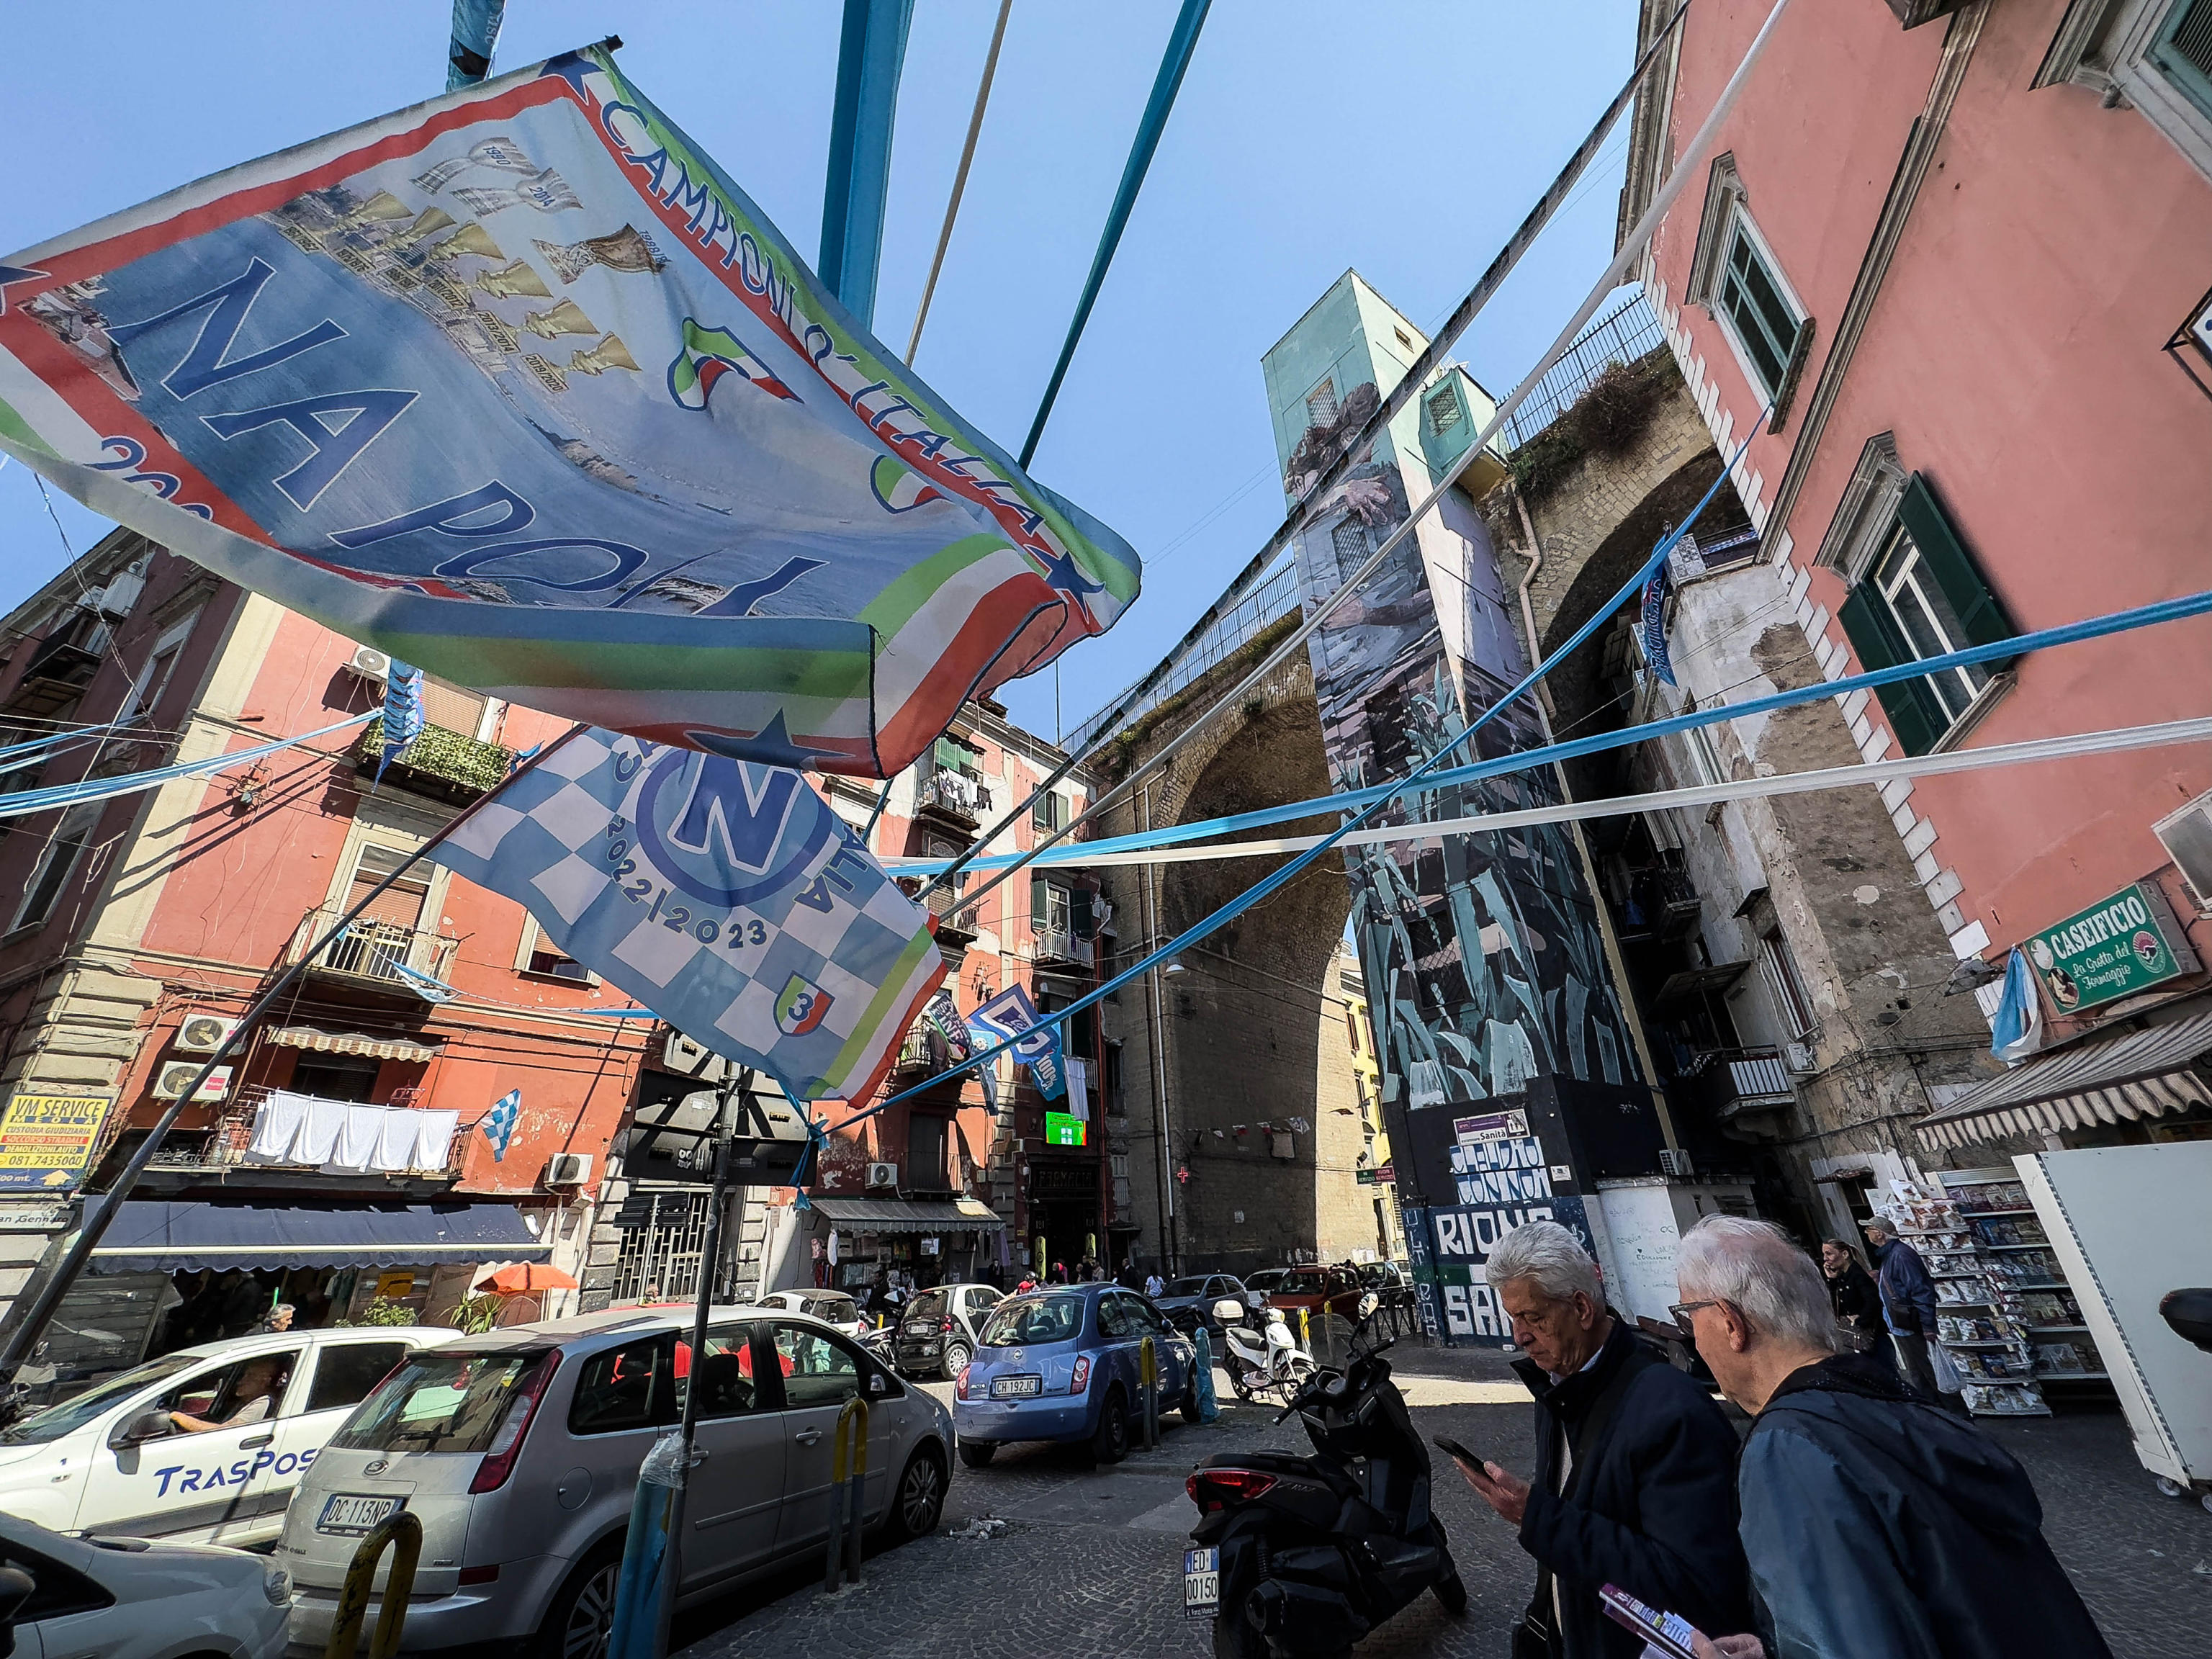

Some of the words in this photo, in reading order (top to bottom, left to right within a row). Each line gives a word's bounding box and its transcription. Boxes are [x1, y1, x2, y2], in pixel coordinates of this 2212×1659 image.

[482, 145, 511, 167] 1990
[528, 186, 557, 207] 2014
[599, 99, 799, 325] CAMPIONI
[479, 311, 513, 354] 2013/2014
[526, 354, 564, 393] 2019/2020
[606, 817, 768, 949] 2022/2023
[2051, 896, 2146, 960] CASEIFICIO
[2072, 963, 2087, 978] La
[2087, 950, 2114, 972] Grotta
[2115, 941, 2132, 960] del
[787, 990, 817, 1022] 3
[14, 1099, 40, 1115] VM
[41, 1100, 103, 1117] SERVICE
[12, 1116, 96, 1125] MEOLA
[1480, 1129, 1506, 1141] Sanità
[9, 1155, 83, 1166] 081.7435000
[997, 1380, 1007, 1393] CH
[1009, 1379, 1035, 1392] 192JC
[327, 1498, 349, 1521] DC
[349, 1499, 392, 1525] 113NP
[1193, 1551, 1206, 1571] ED
[1187, 1577, 1217, 1600] 00150
